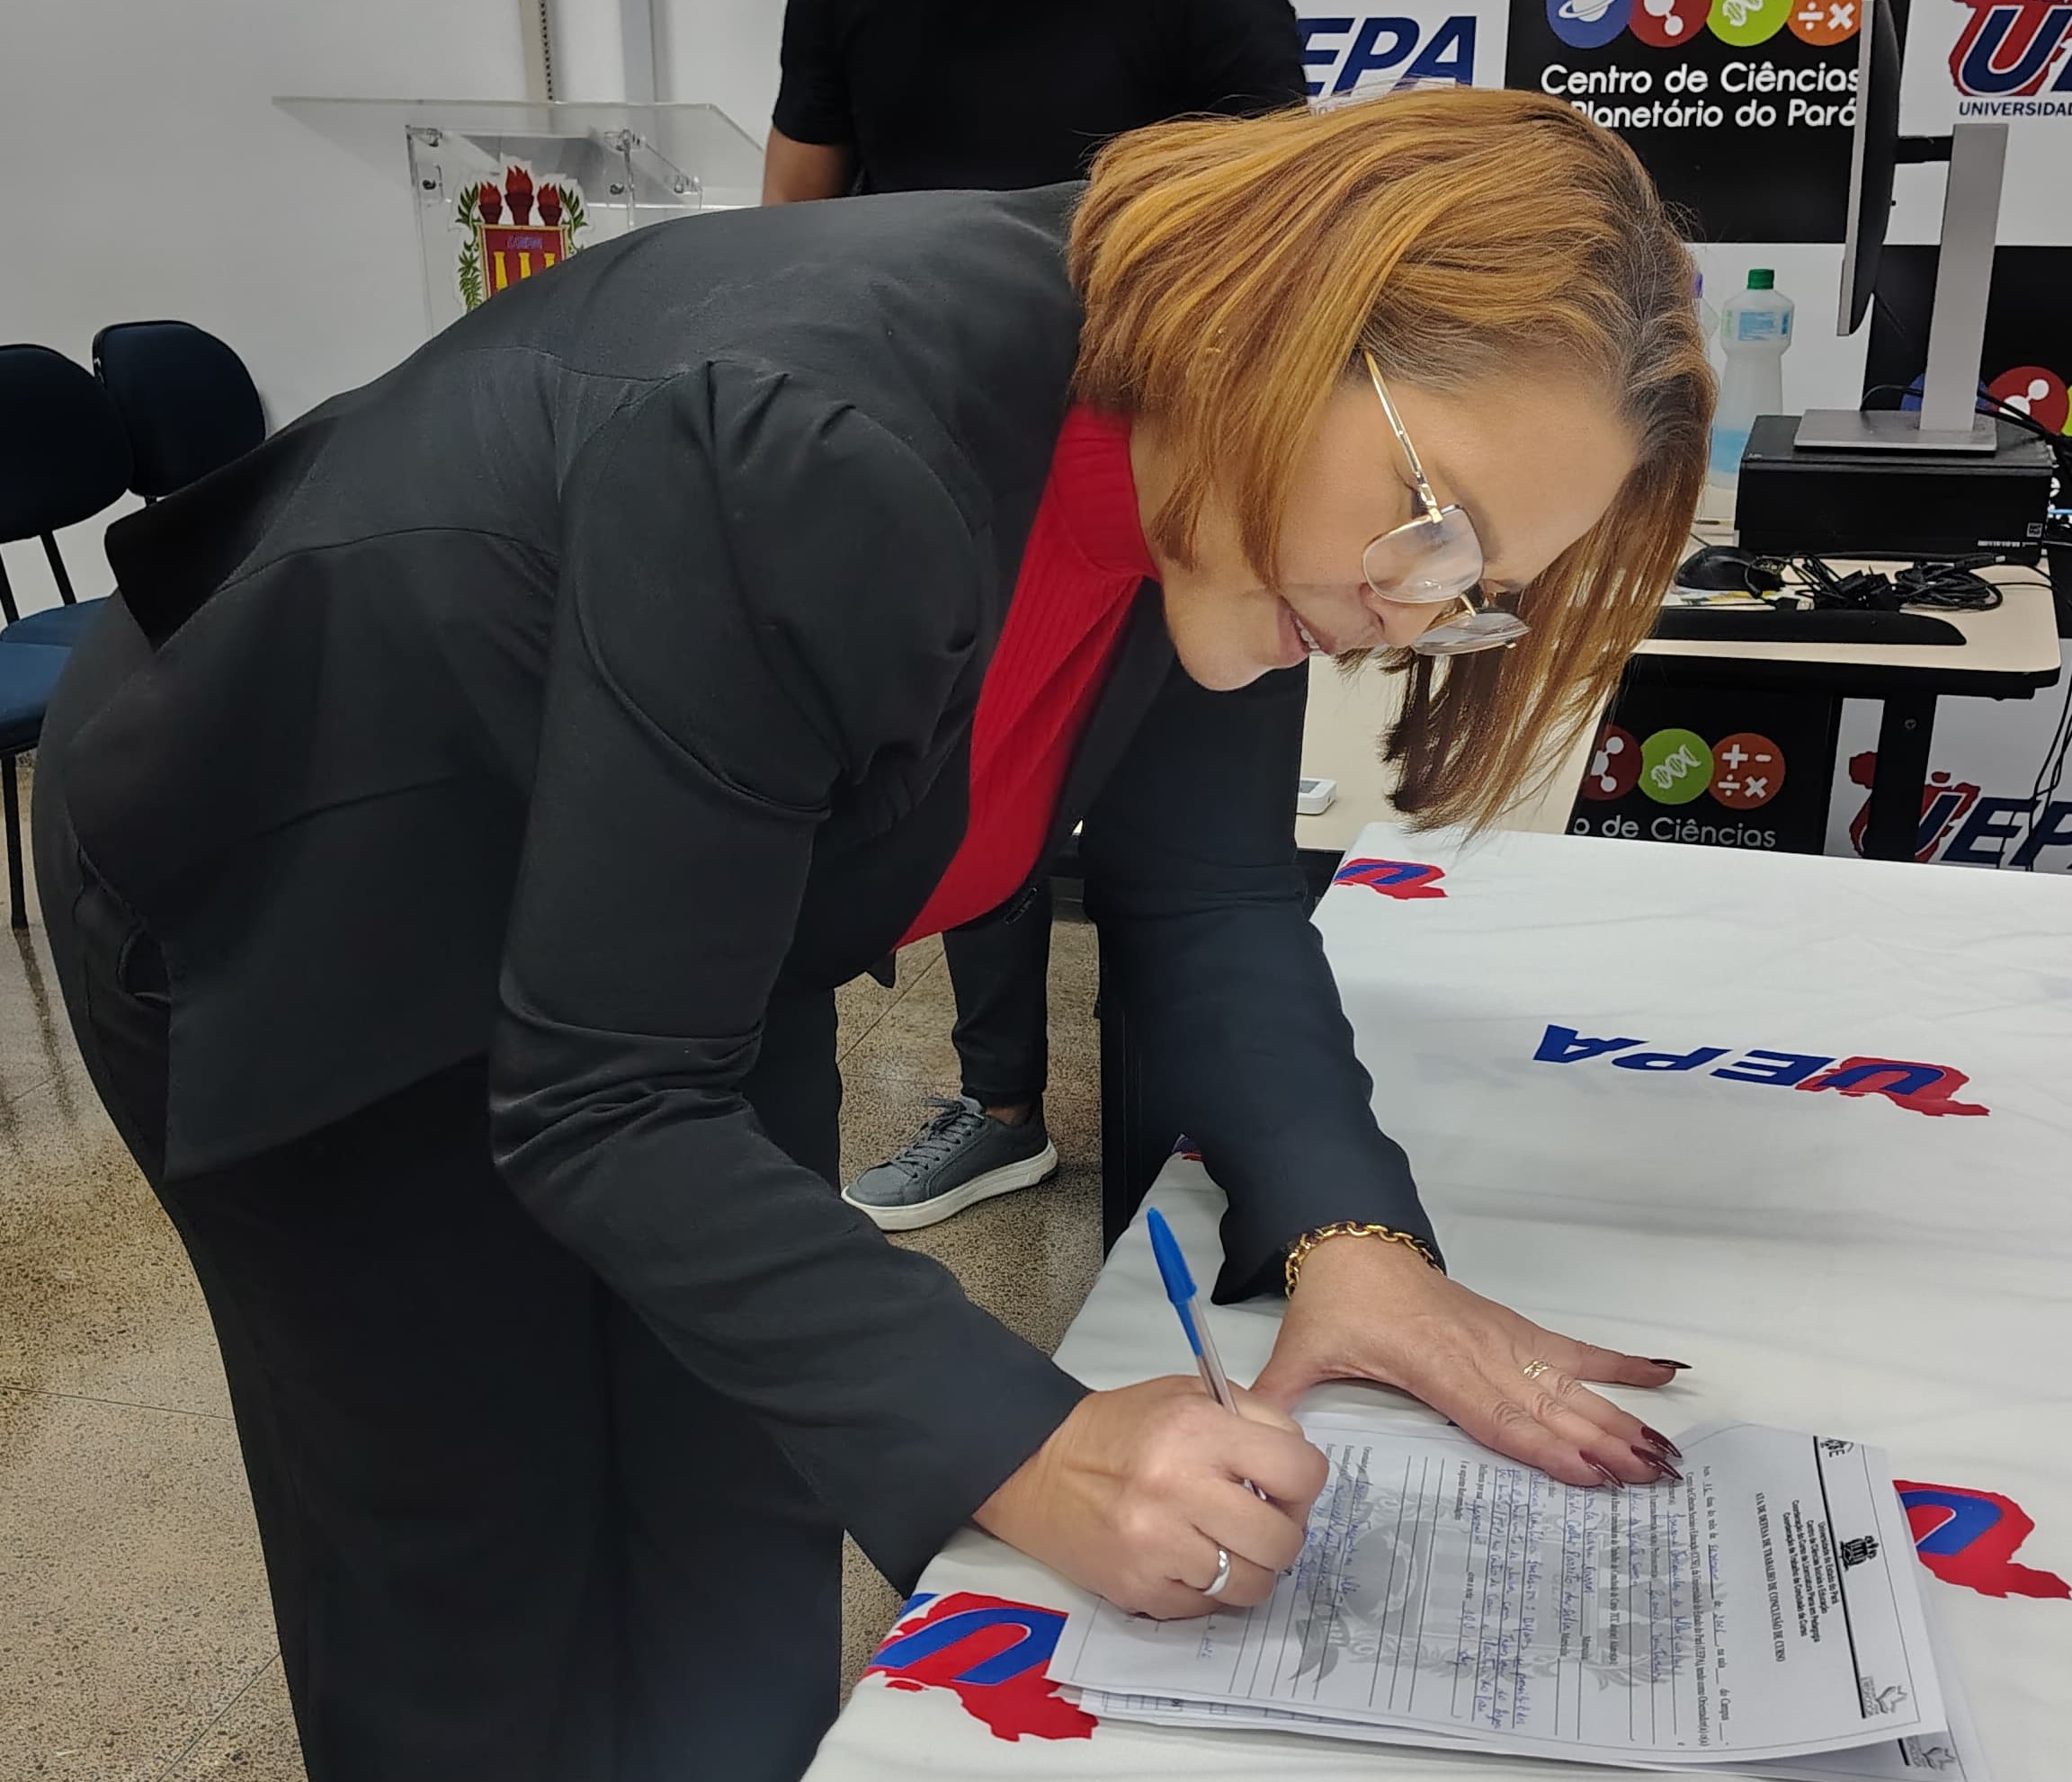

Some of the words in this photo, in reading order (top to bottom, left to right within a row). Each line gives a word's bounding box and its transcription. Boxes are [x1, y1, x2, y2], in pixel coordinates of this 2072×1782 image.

[1541, 64, 1653, 94] Centro
[1665, 63, 1709, 94] de
[1720, 61, 1859, 92] Ciências
[1735, 99, 1777, 127] do
[1788, 98, 1858, 127] Pará
[1601, 815, 1639, 839] de
[1651, 816, 1776, 849] Ciências
[1533, 1024, 1945, 1097] UEPA
[1754, 1492, 1765, 1505] ATA
[1755, 1505, 1766, 1514] DE
[1760, 1538, 1772, 1548] DE
[1817, 1521, 1831, 1555] Universidade
[1762, 1547, 1776, 1582] TRABALHO
[1805, 1519, 1816, 1537] Centro
[1817, 1588, 1830, 1614] Educação
[1824, 1563, 1836, 1582] Estado
[1766, 1582, 1778, 1591] DE
[1829, 1590, 1840, 1604] Pará
[1767, 1590, 1783, 1630] CONCLUSÃO
[1773, 1629, 1784, 1640] DE
[1800, 1619, 1809, 1635] Curso
[1774, 1640, 1787, 1663] CURSO
